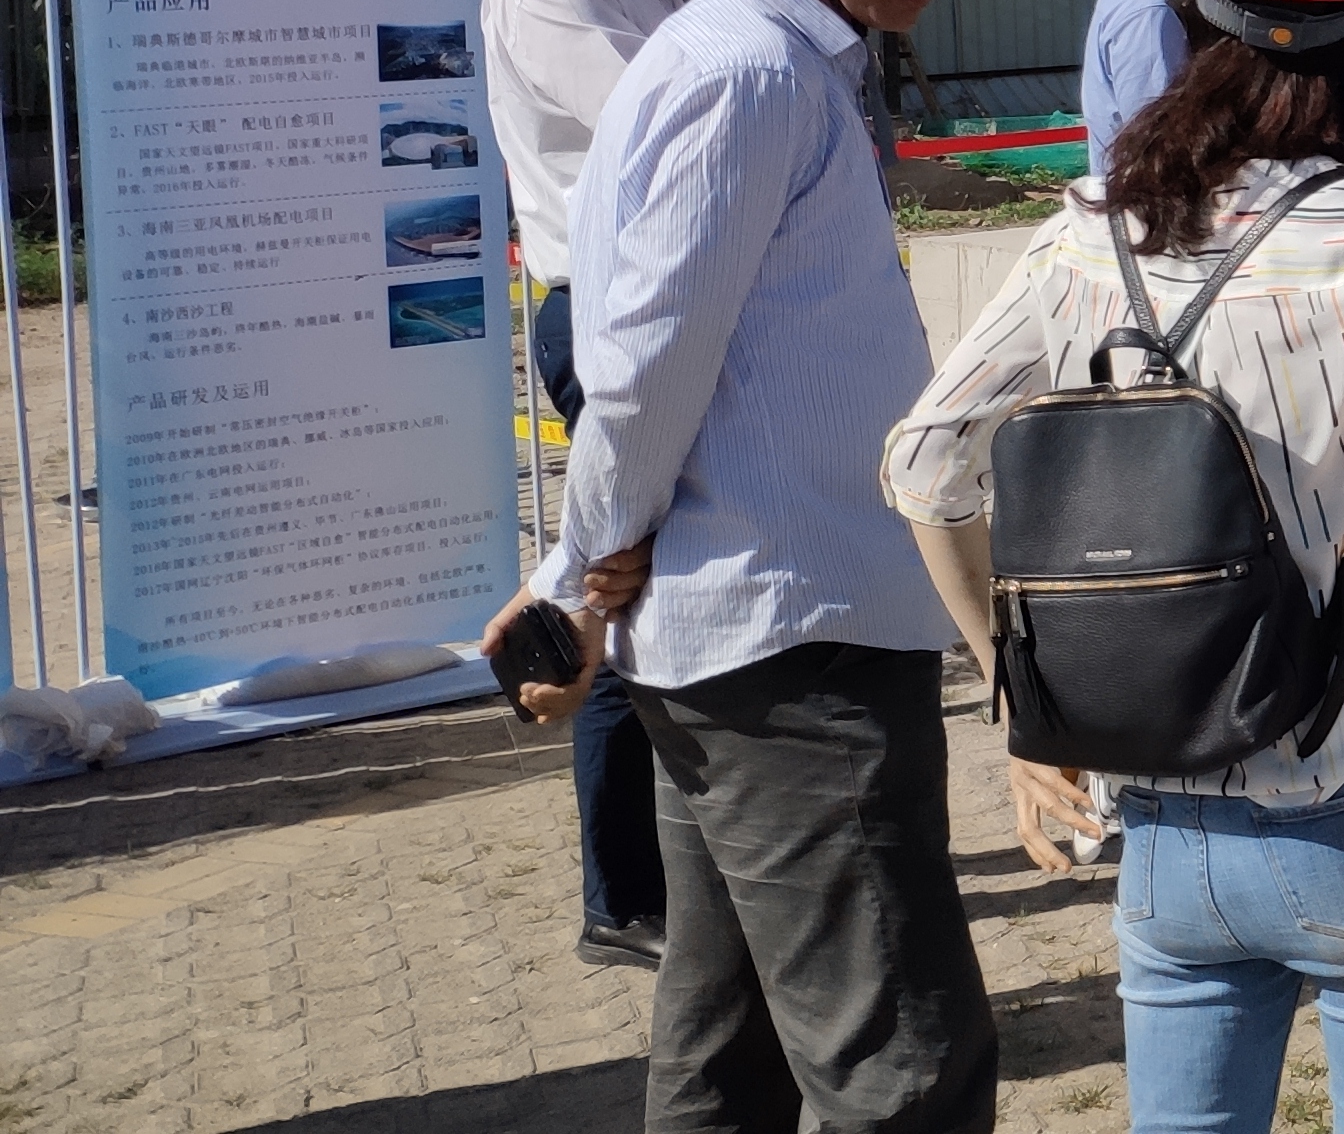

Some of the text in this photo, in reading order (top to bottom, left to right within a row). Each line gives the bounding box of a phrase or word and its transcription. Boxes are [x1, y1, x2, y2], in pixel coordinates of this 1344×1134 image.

[127, 379, 270, 413] 产品研发及运用
